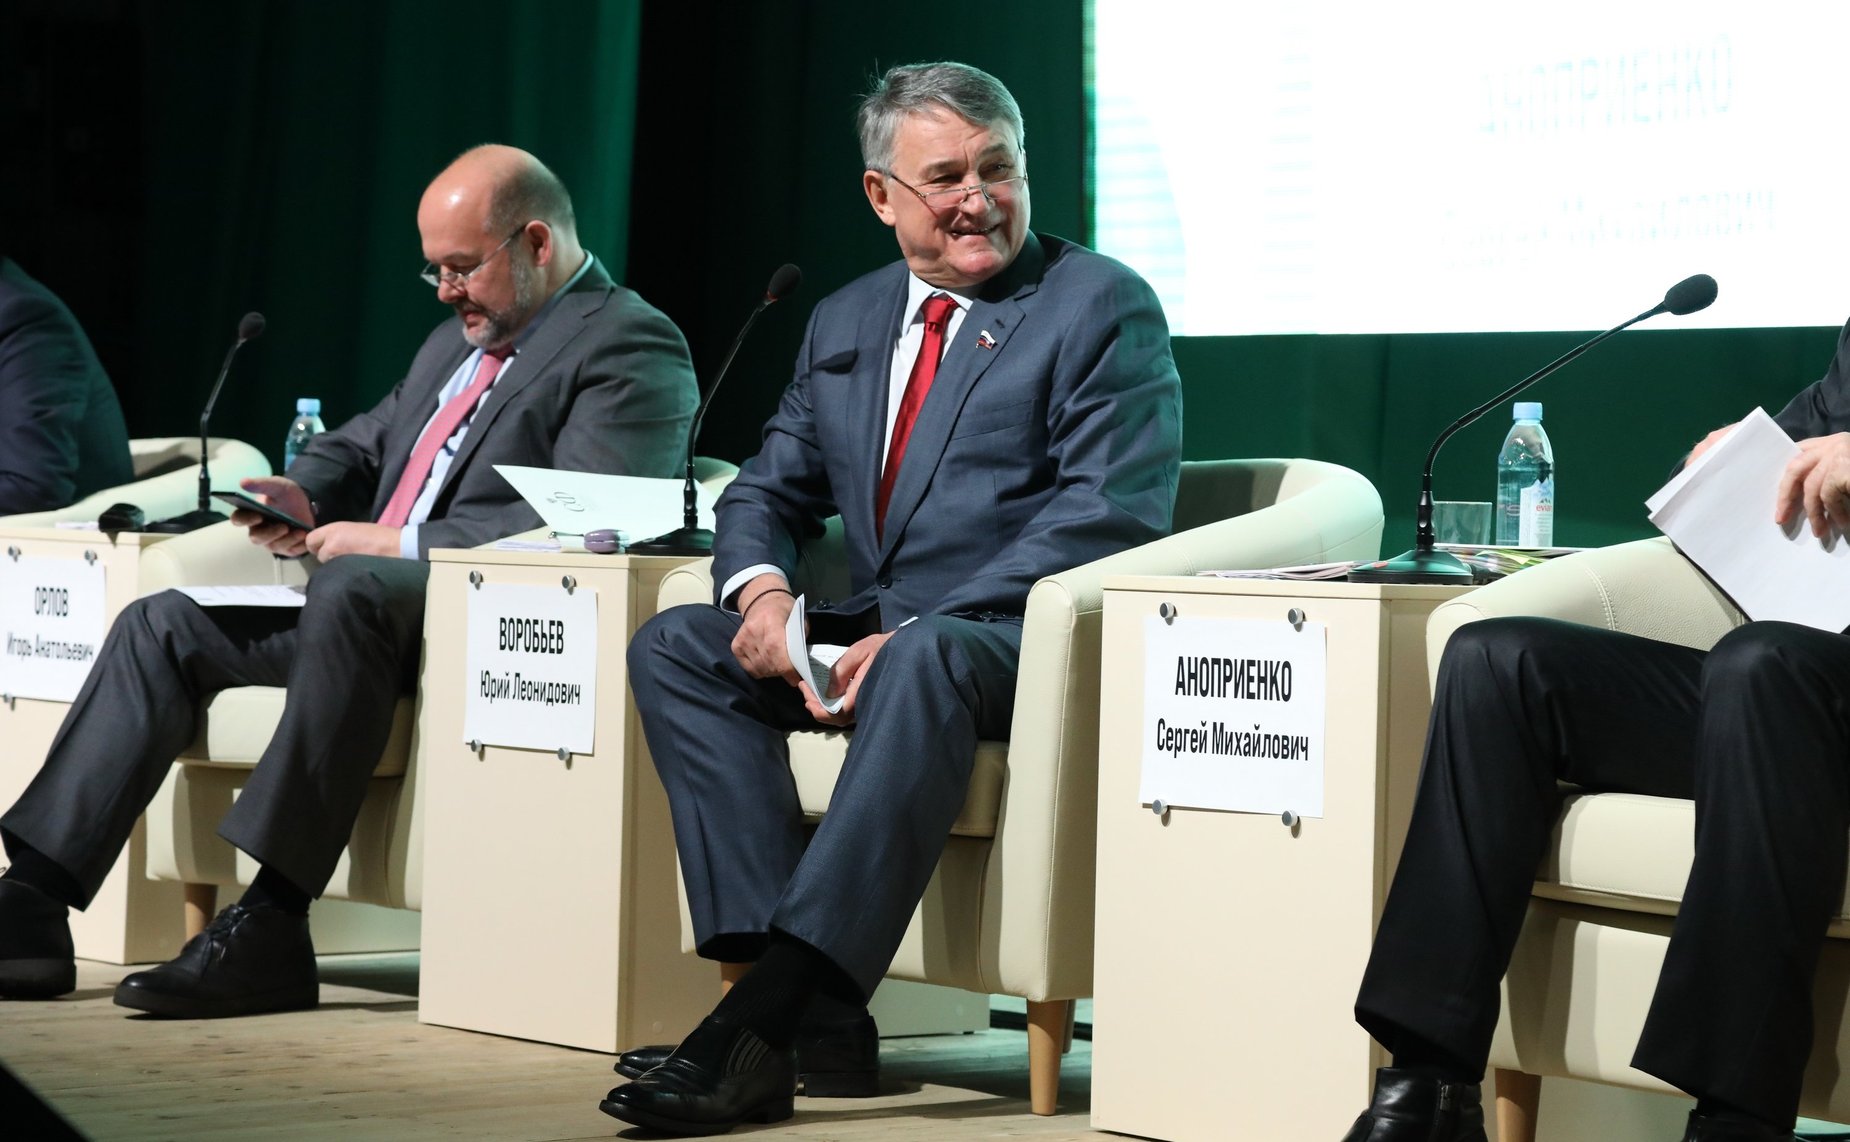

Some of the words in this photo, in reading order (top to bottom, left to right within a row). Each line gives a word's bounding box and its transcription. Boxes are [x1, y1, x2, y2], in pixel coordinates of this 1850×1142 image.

[34, 586, 69, 617] ОРЛОВ
[499, 617, 564, 654] ВОРОБЬЕВ
[480, 670, 510, 703] Юрий
[512, 672, 581, 706] Леонидович
[1174, 656, 1292, 702] АНОПРИЕНКО
[1156, 718, 1208, 758] Сергей
[1211, 721, 1309, 761] Михайлович
